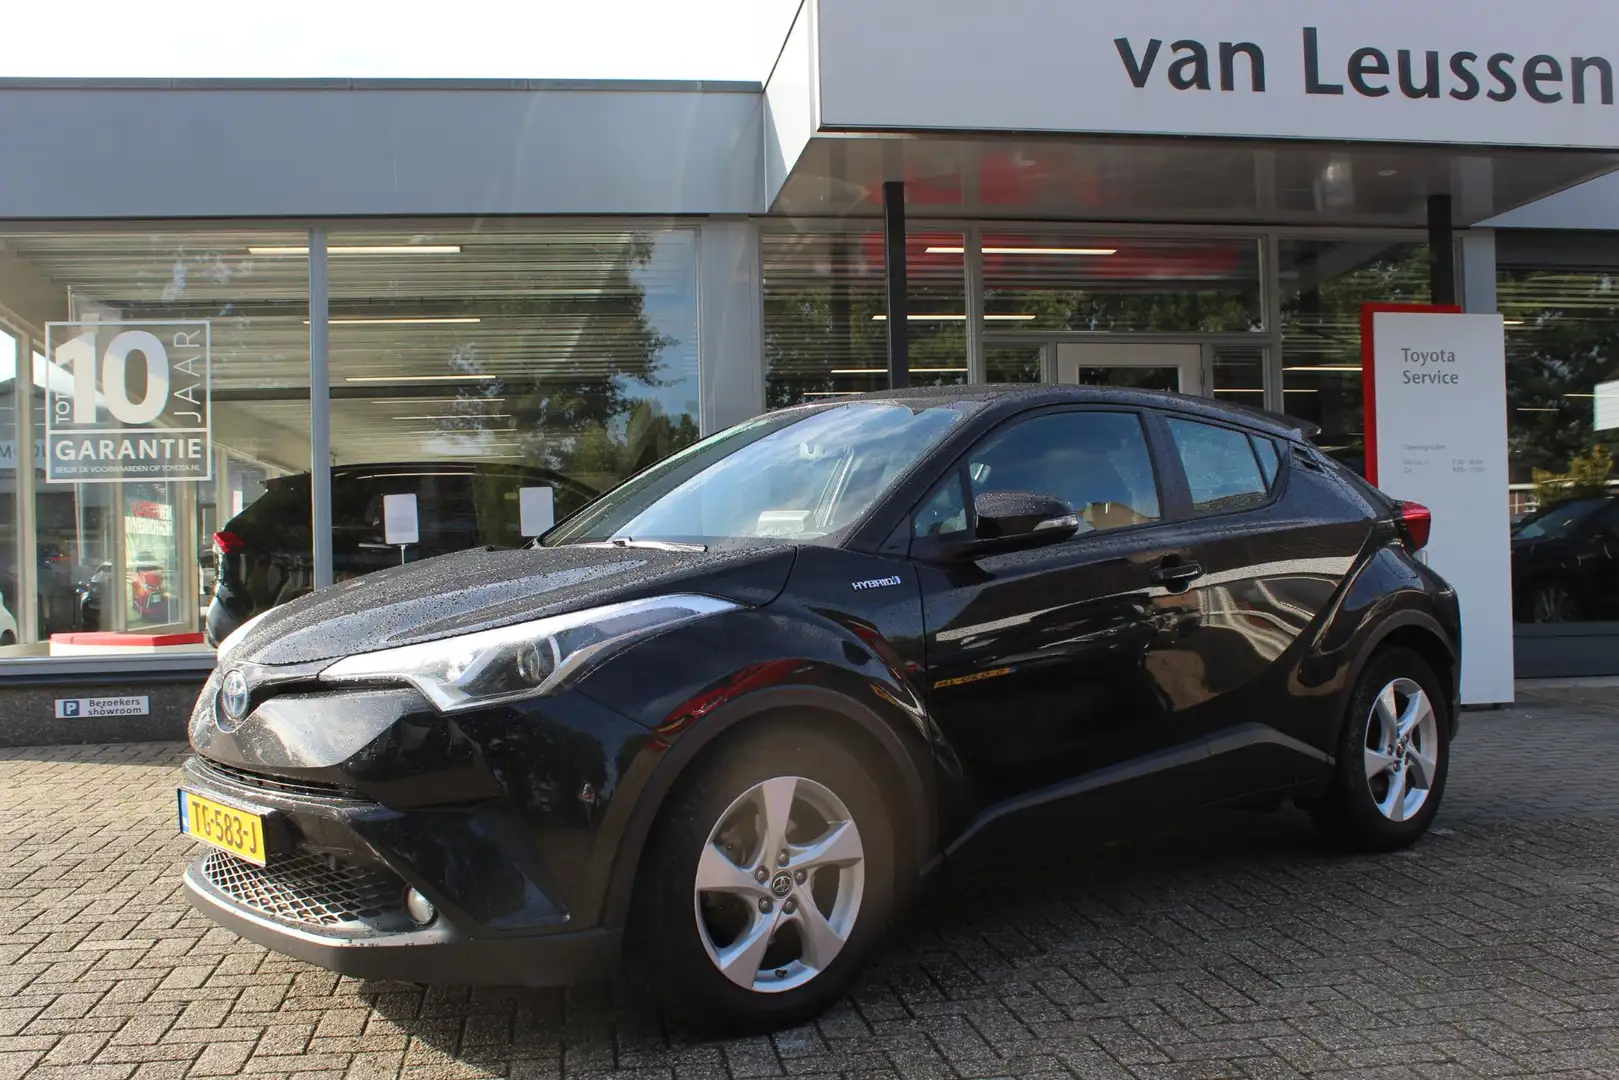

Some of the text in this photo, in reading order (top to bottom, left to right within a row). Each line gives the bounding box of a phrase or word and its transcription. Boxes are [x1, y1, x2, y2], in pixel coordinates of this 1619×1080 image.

[1114, 27, 1614, 105] van Leussen
[1400, 347, 1456, 367] Toyota
[55, 330, 169, 425] 10
[173, 329, 201, 423] JAAR
[1402, 370, 1459, 385] Service
[55, 393, 70, 424] TOT
[55, 438, 202, 461] GARANTIE
[91, 465, 148, 473] VOORWAARDEN
[852, 577, 897, 590] HYBRID
[88, 707, 142, 716] showroom
[89, 699, 140, 708] Bezoekers
[192, 800, 257, 854] TG-583-J
